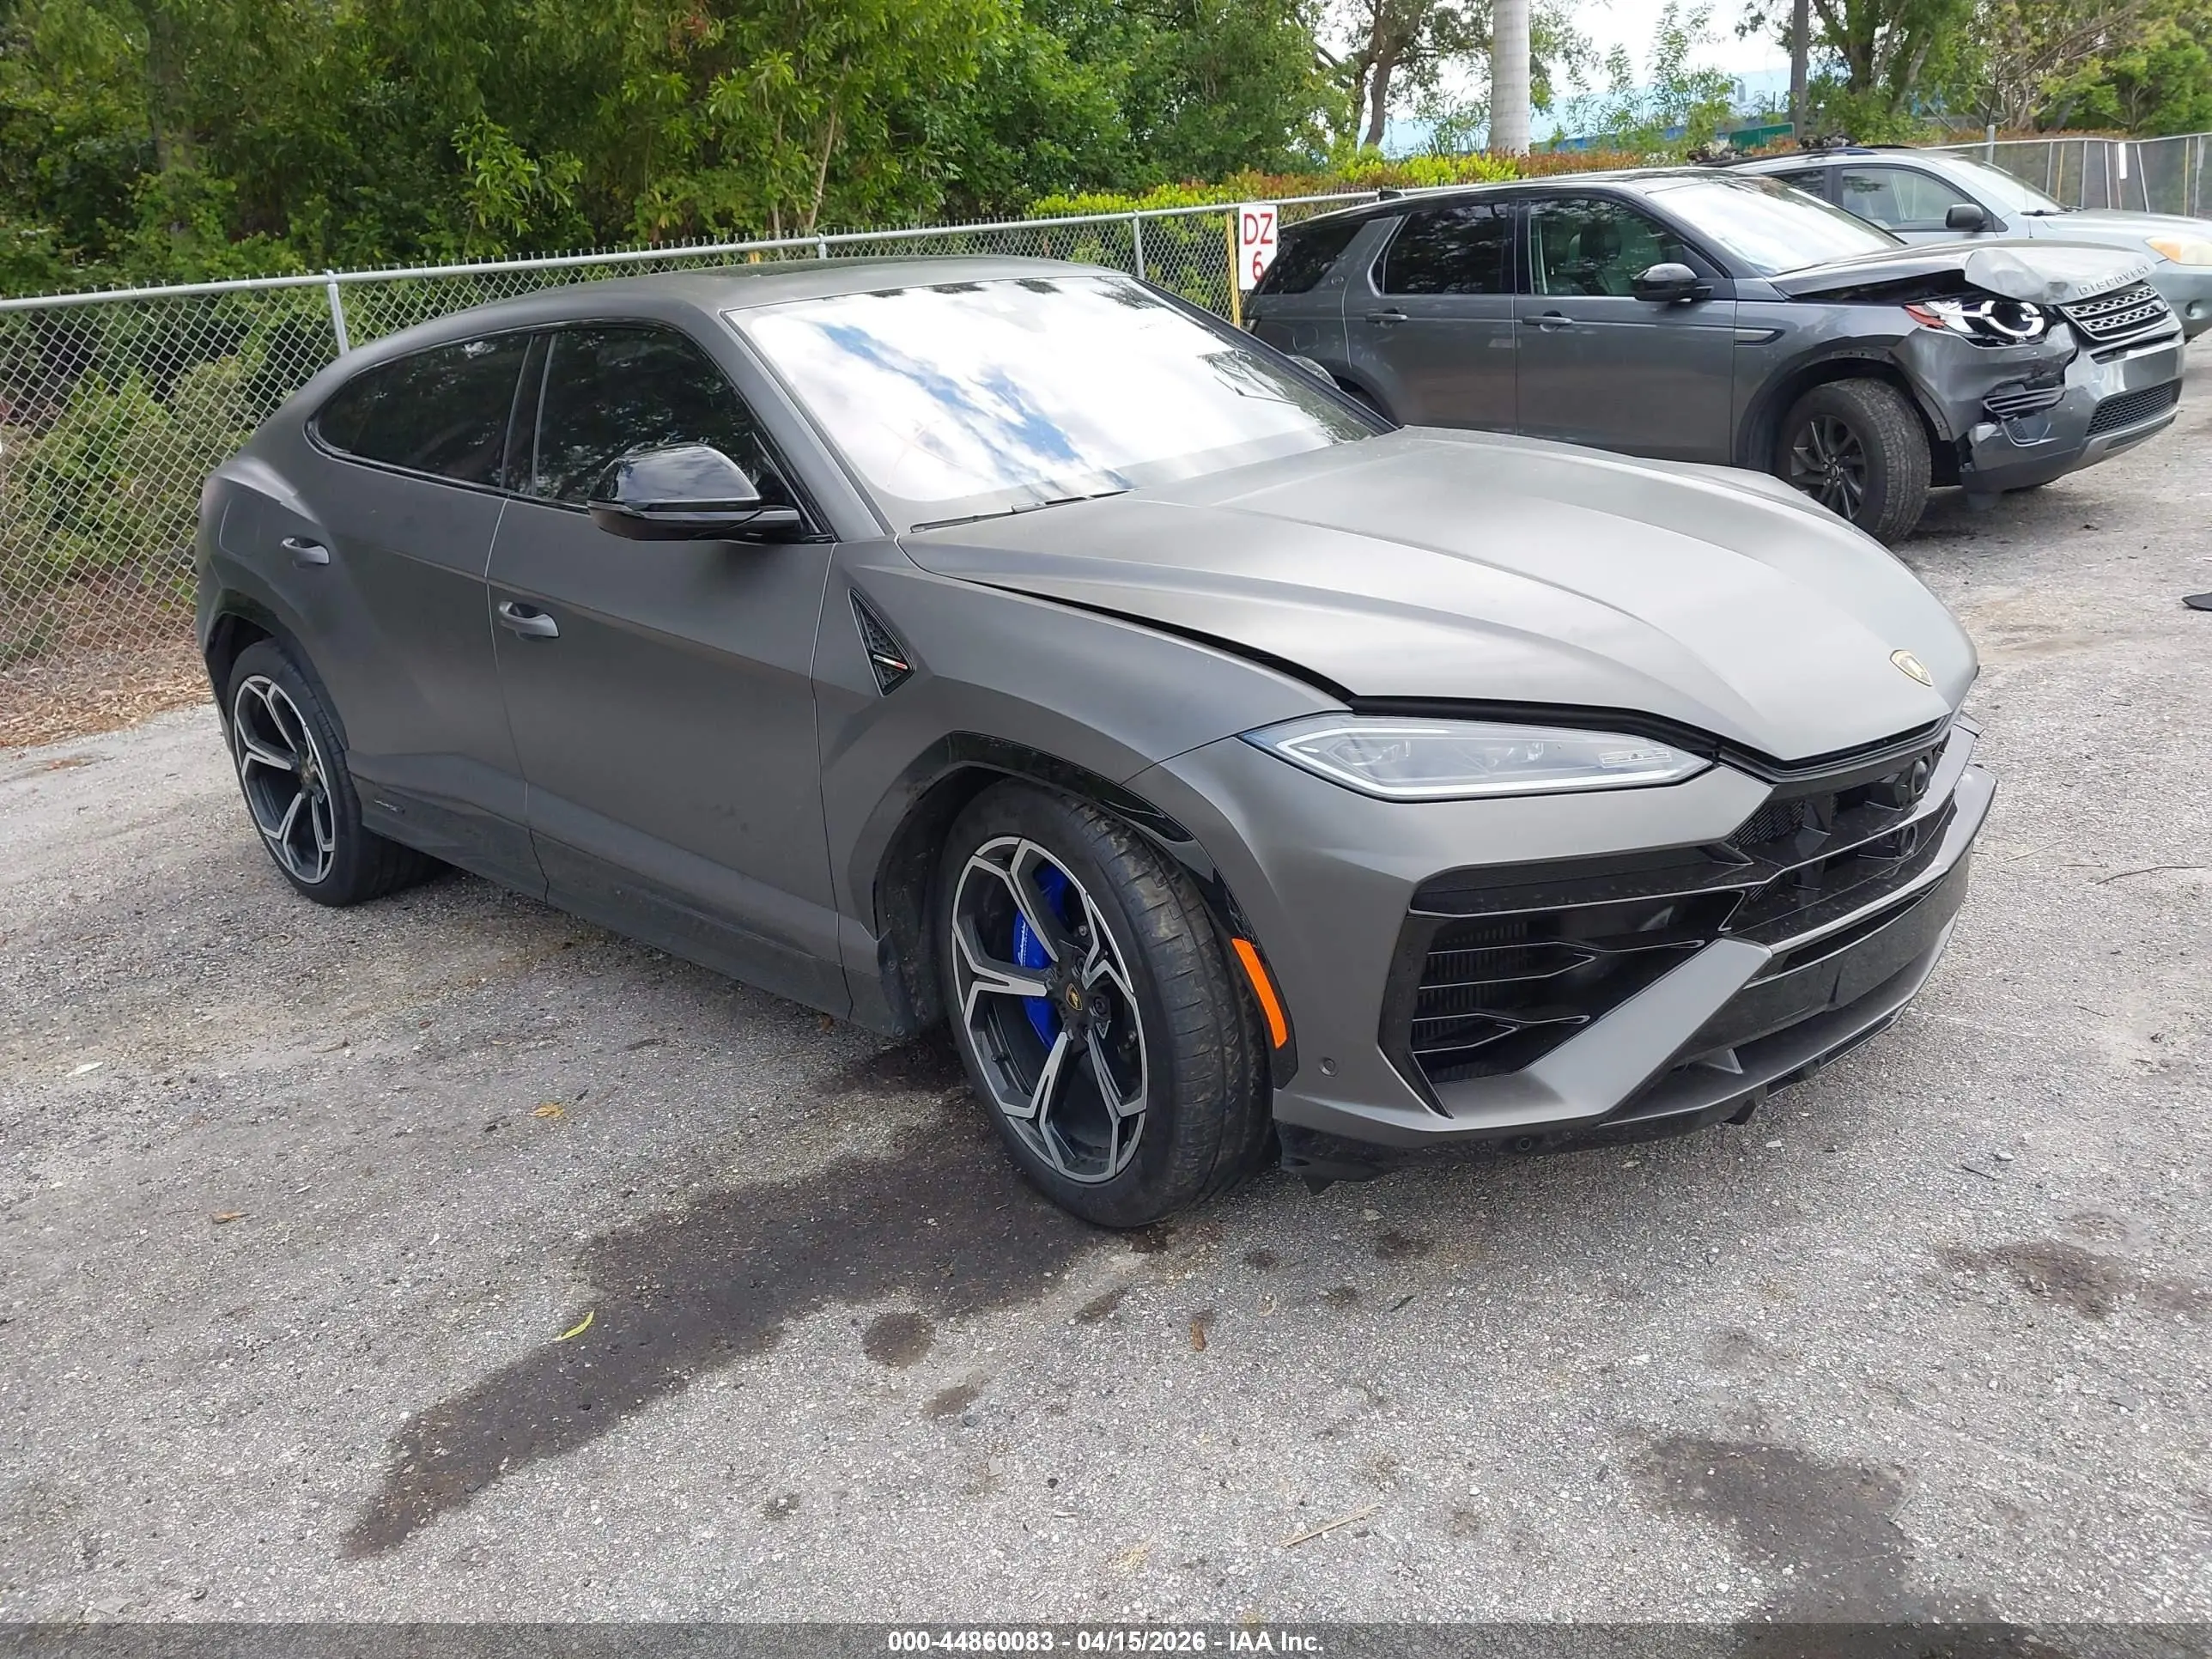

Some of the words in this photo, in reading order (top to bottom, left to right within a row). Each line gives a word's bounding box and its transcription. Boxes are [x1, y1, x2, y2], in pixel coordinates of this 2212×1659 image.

[1243, 213, 1273, 245] DZ
[1252, 250, 1265, 283] 6
[2077, 264, 2149, 296] DISCOVERY
